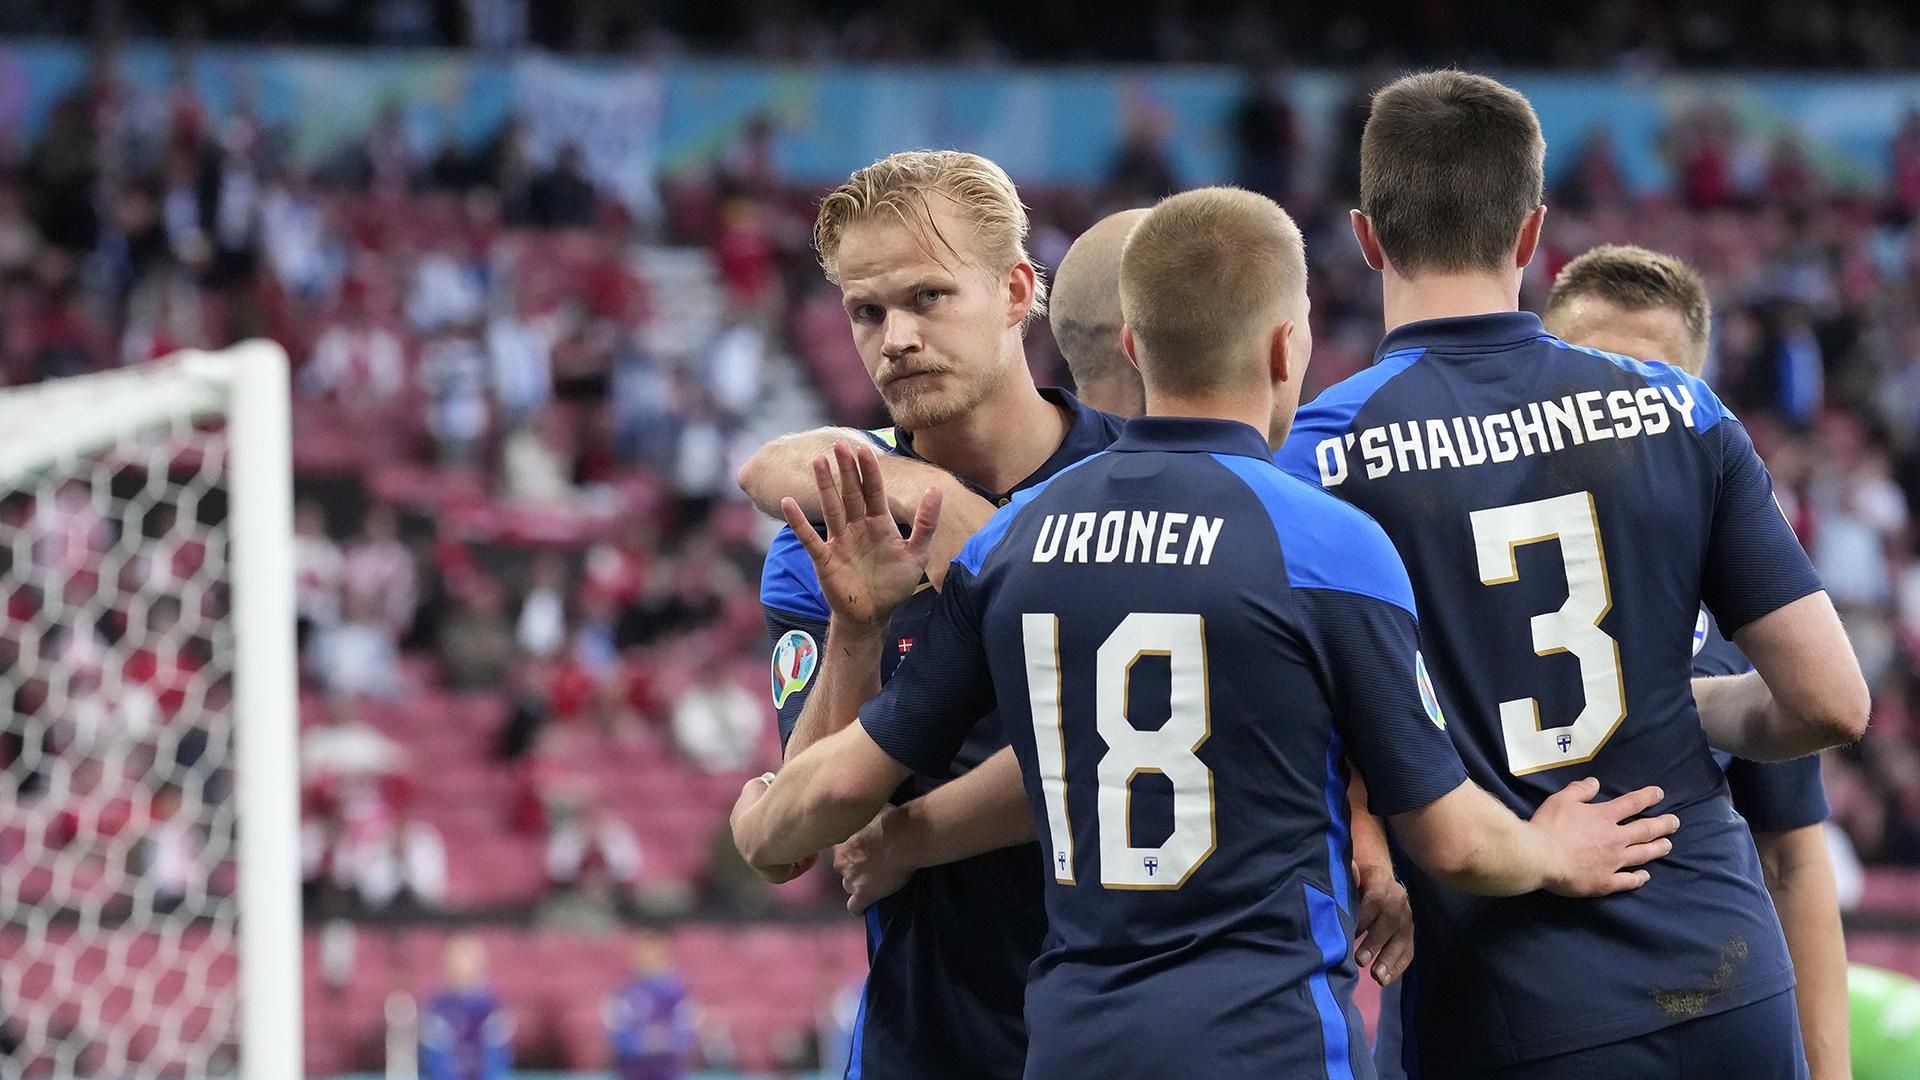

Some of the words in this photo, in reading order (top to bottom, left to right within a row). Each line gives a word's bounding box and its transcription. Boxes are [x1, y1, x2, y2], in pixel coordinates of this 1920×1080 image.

[1316, 384, 1696, 487] O'SHAUGHNESSY
[1032, 510, 1224, 565] URONEN
[1470, 491, 1627, 776] 3
[1022, 613, 1216, 890] 18
